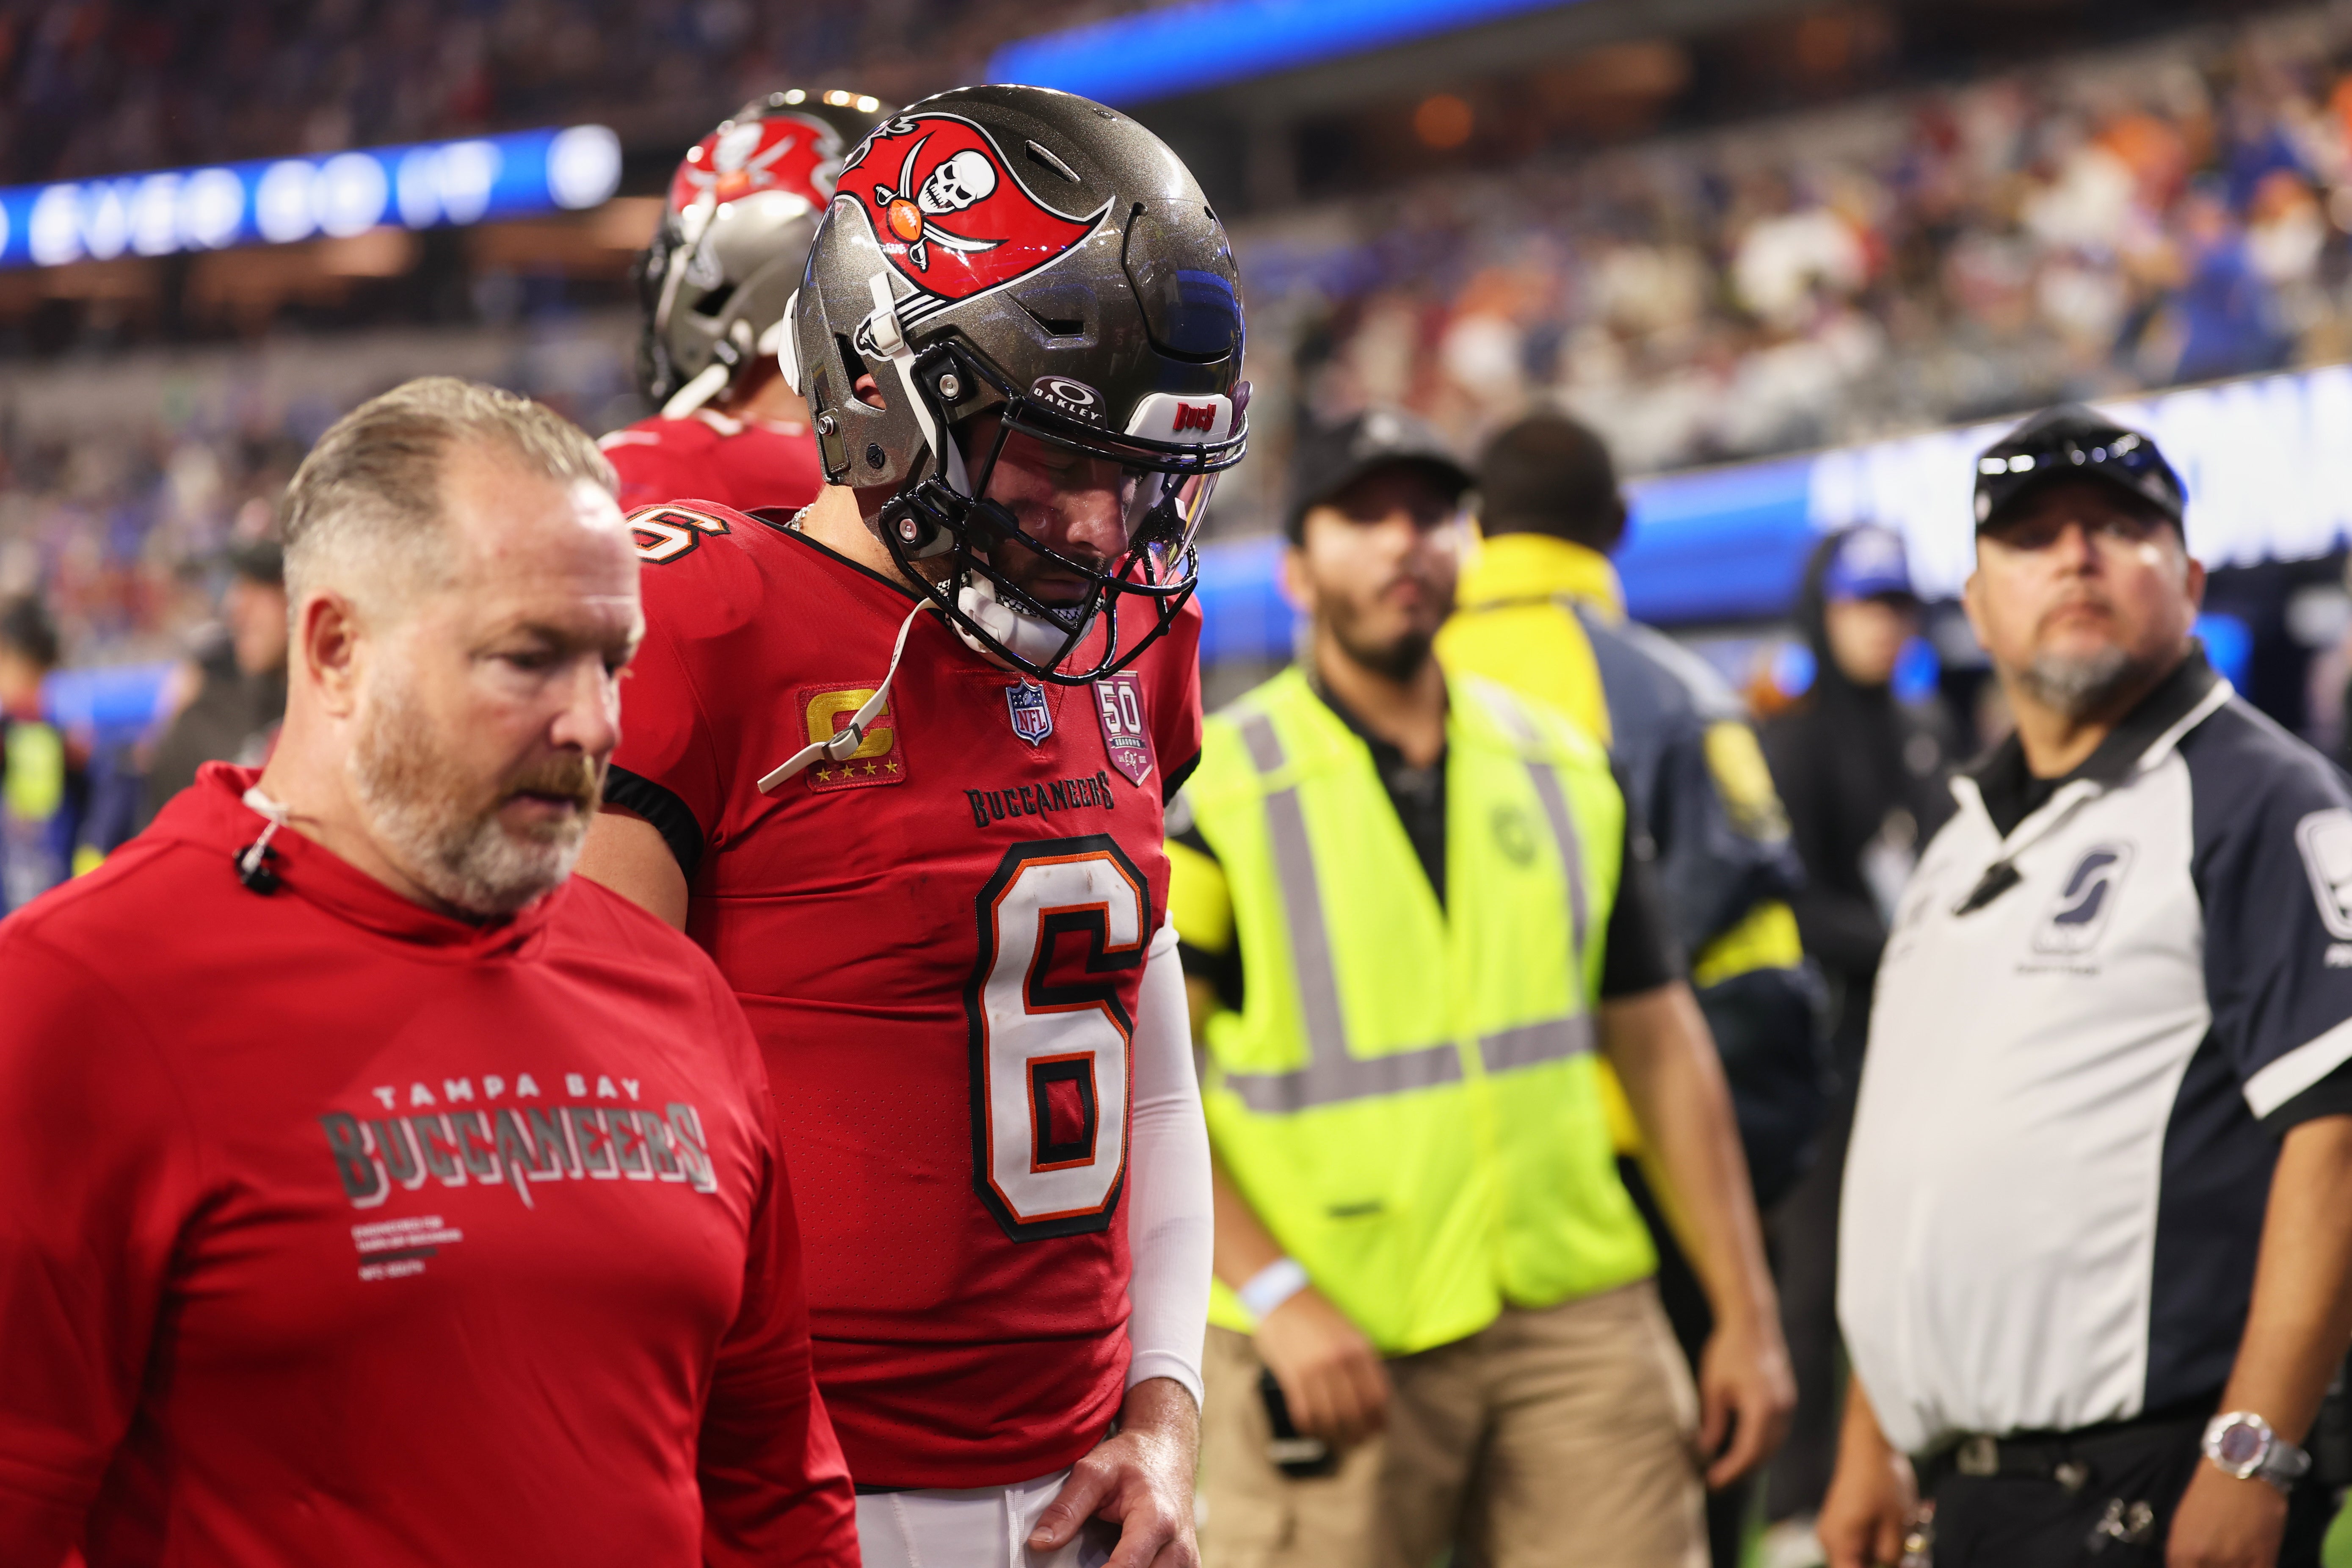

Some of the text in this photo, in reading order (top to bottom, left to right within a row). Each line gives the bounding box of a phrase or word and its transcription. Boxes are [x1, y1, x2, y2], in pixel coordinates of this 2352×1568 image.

[1033, 388, 1099, 420] OAKLEY
[1173, 402, 1217, 431] BUCS
[806, 688, 893, 760] C
[1017, 709, 1046, 734] NFL
[1096, 681, 1142, 736] 50
[963, 770, 1114, 828] BUCCANEERS
[963, 833, 1151, 1244] 6
[373, 1072, 640, 1109] TAMPA BAY
[319, 1103, 718, 1209] BUCCANEERS
